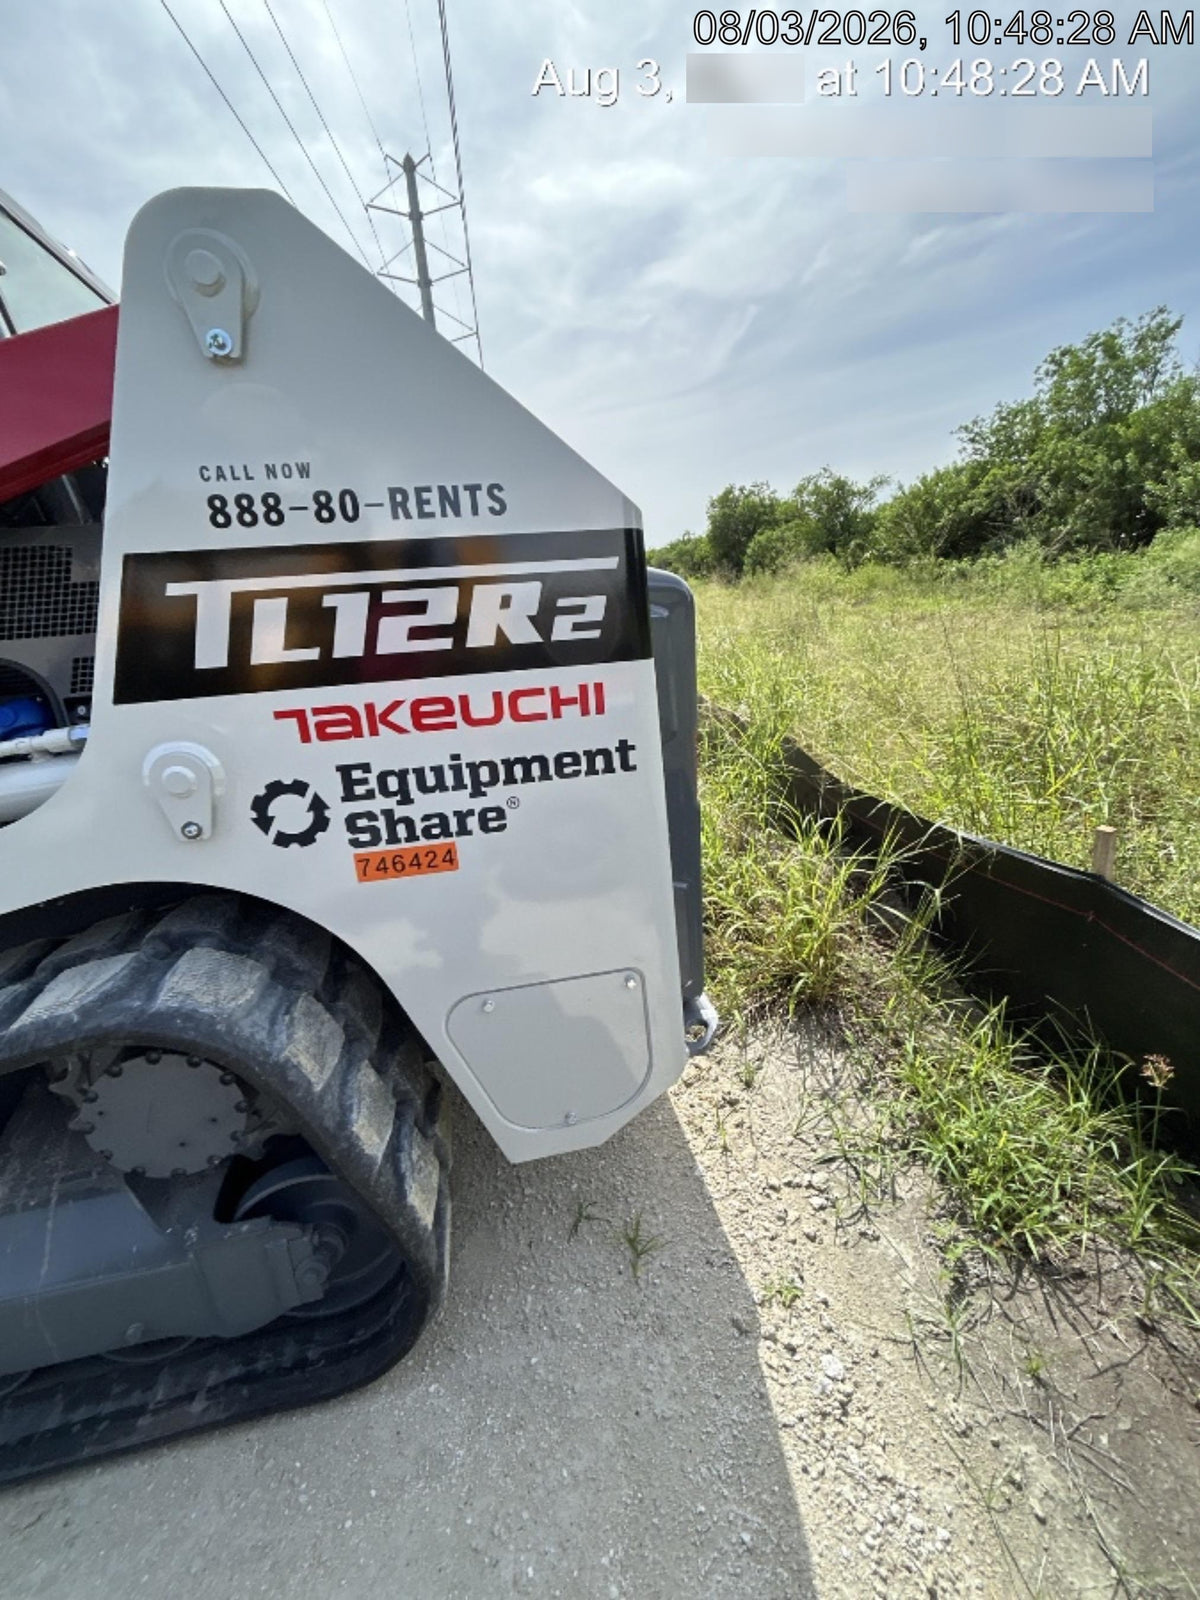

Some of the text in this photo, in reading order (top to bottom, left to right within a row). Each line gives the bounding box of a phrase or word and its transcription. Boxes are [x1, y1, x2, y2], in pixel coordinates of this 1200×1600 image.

[199, 461, 312, 482] CALL NOW
[207, 483, 508, 529] 888-80-RENTS
[335, 739, 638, 806] Equipment
[356, 848, 457, 877] 746424
